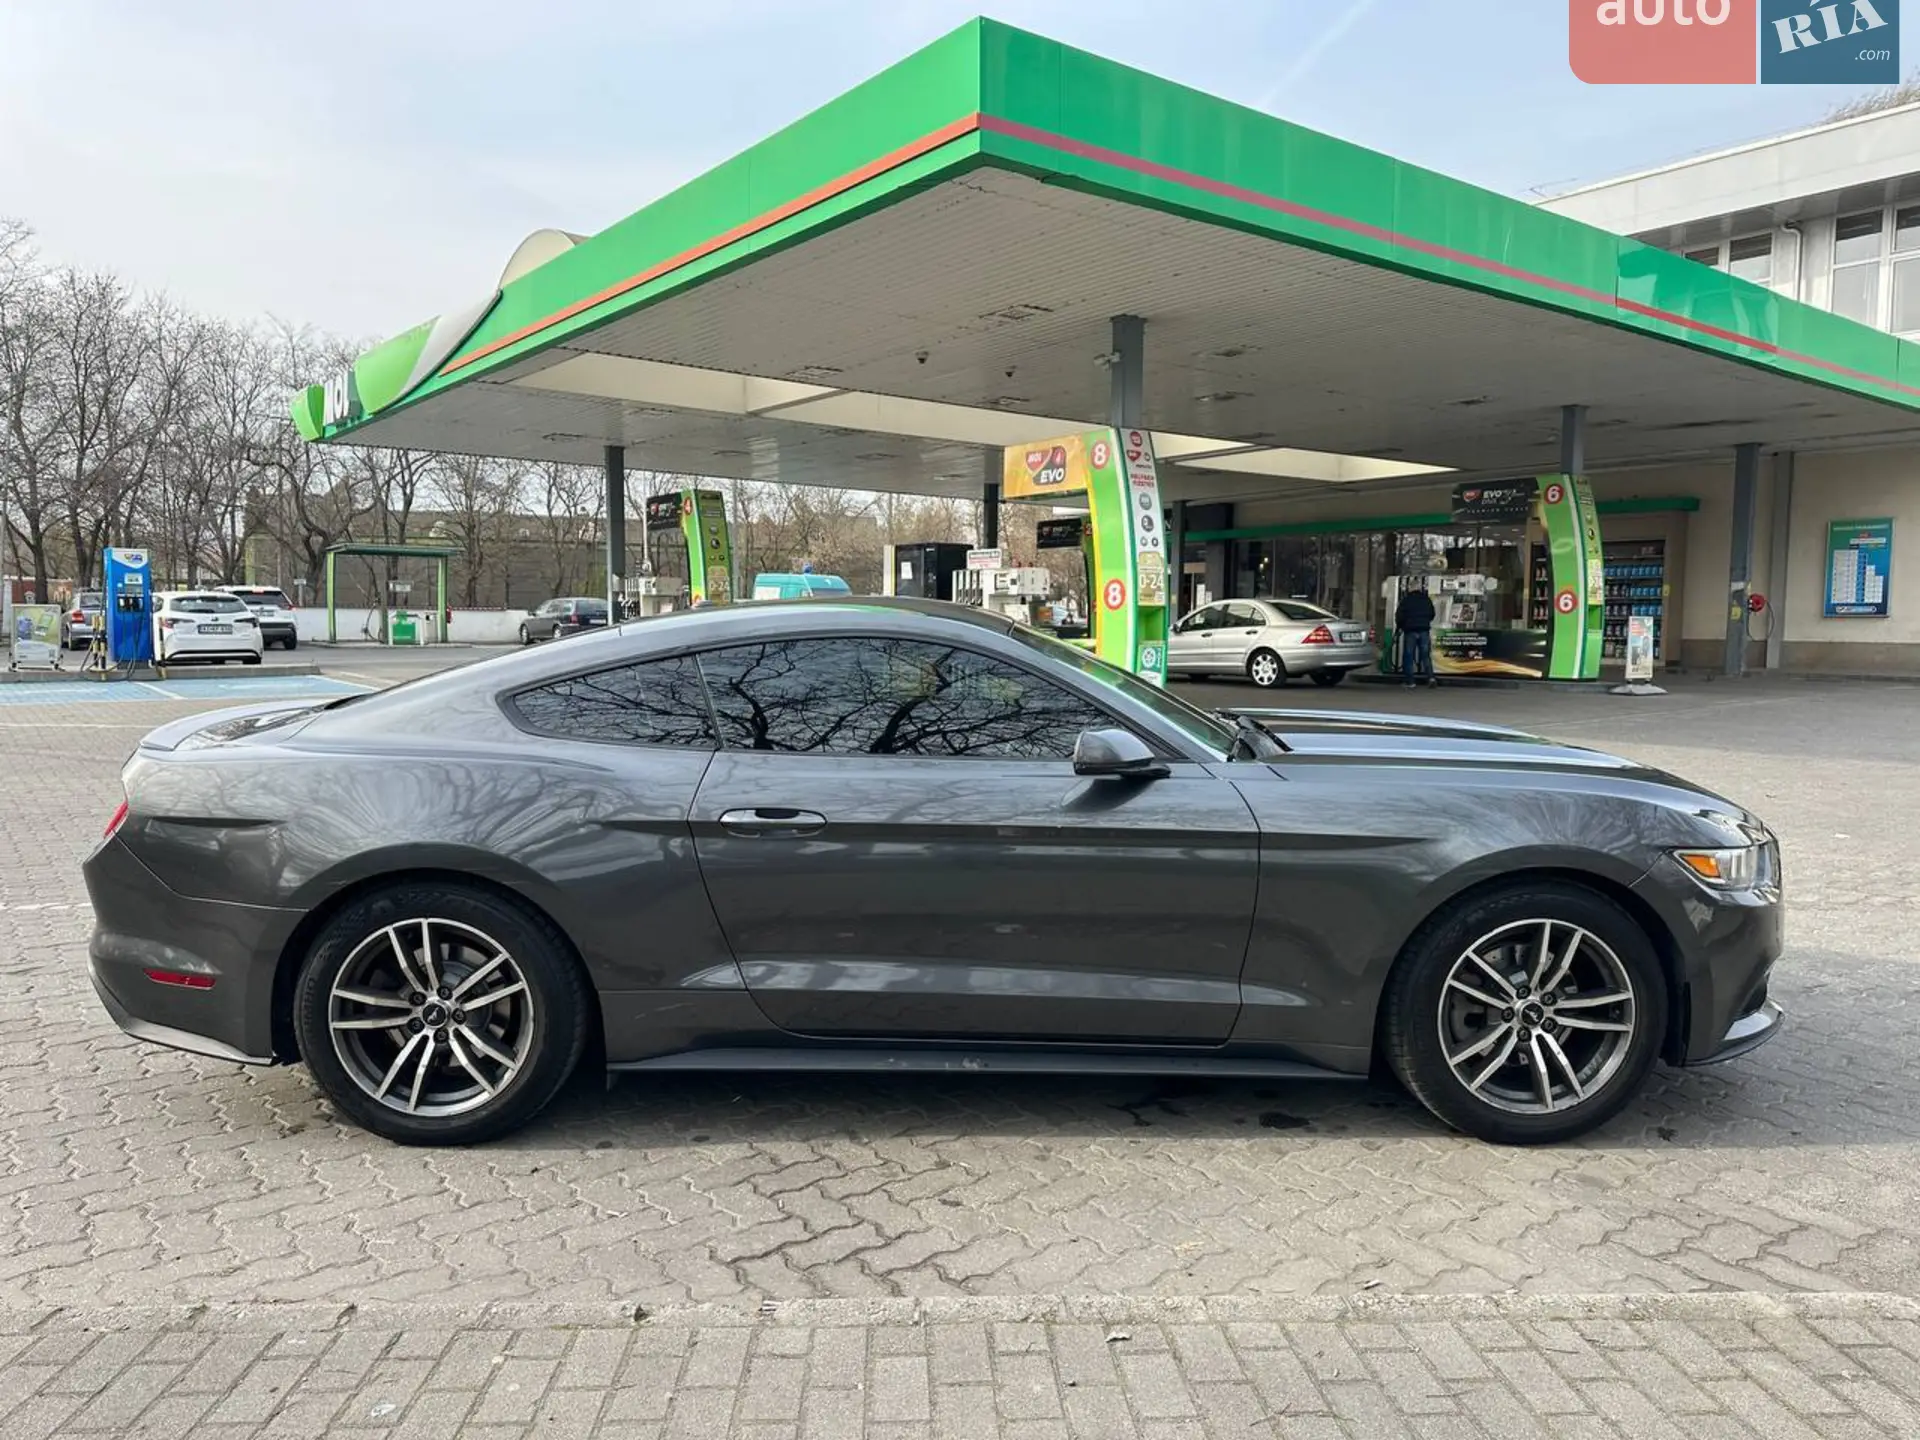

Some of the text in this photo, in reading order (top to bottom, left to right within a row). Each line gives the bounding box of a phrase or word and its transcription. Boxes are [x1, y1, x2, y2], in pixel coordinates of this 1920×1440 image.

[1094, 443, 1106, 466] 8
[1040, 467, 1065, 484] EVO
[1483, 489, 1502, 499] EVO
[1547, 485, 1561, 504] 6
[1107, 581, 1122, 607] 8
[1559, 593, 1573, 609] 6
